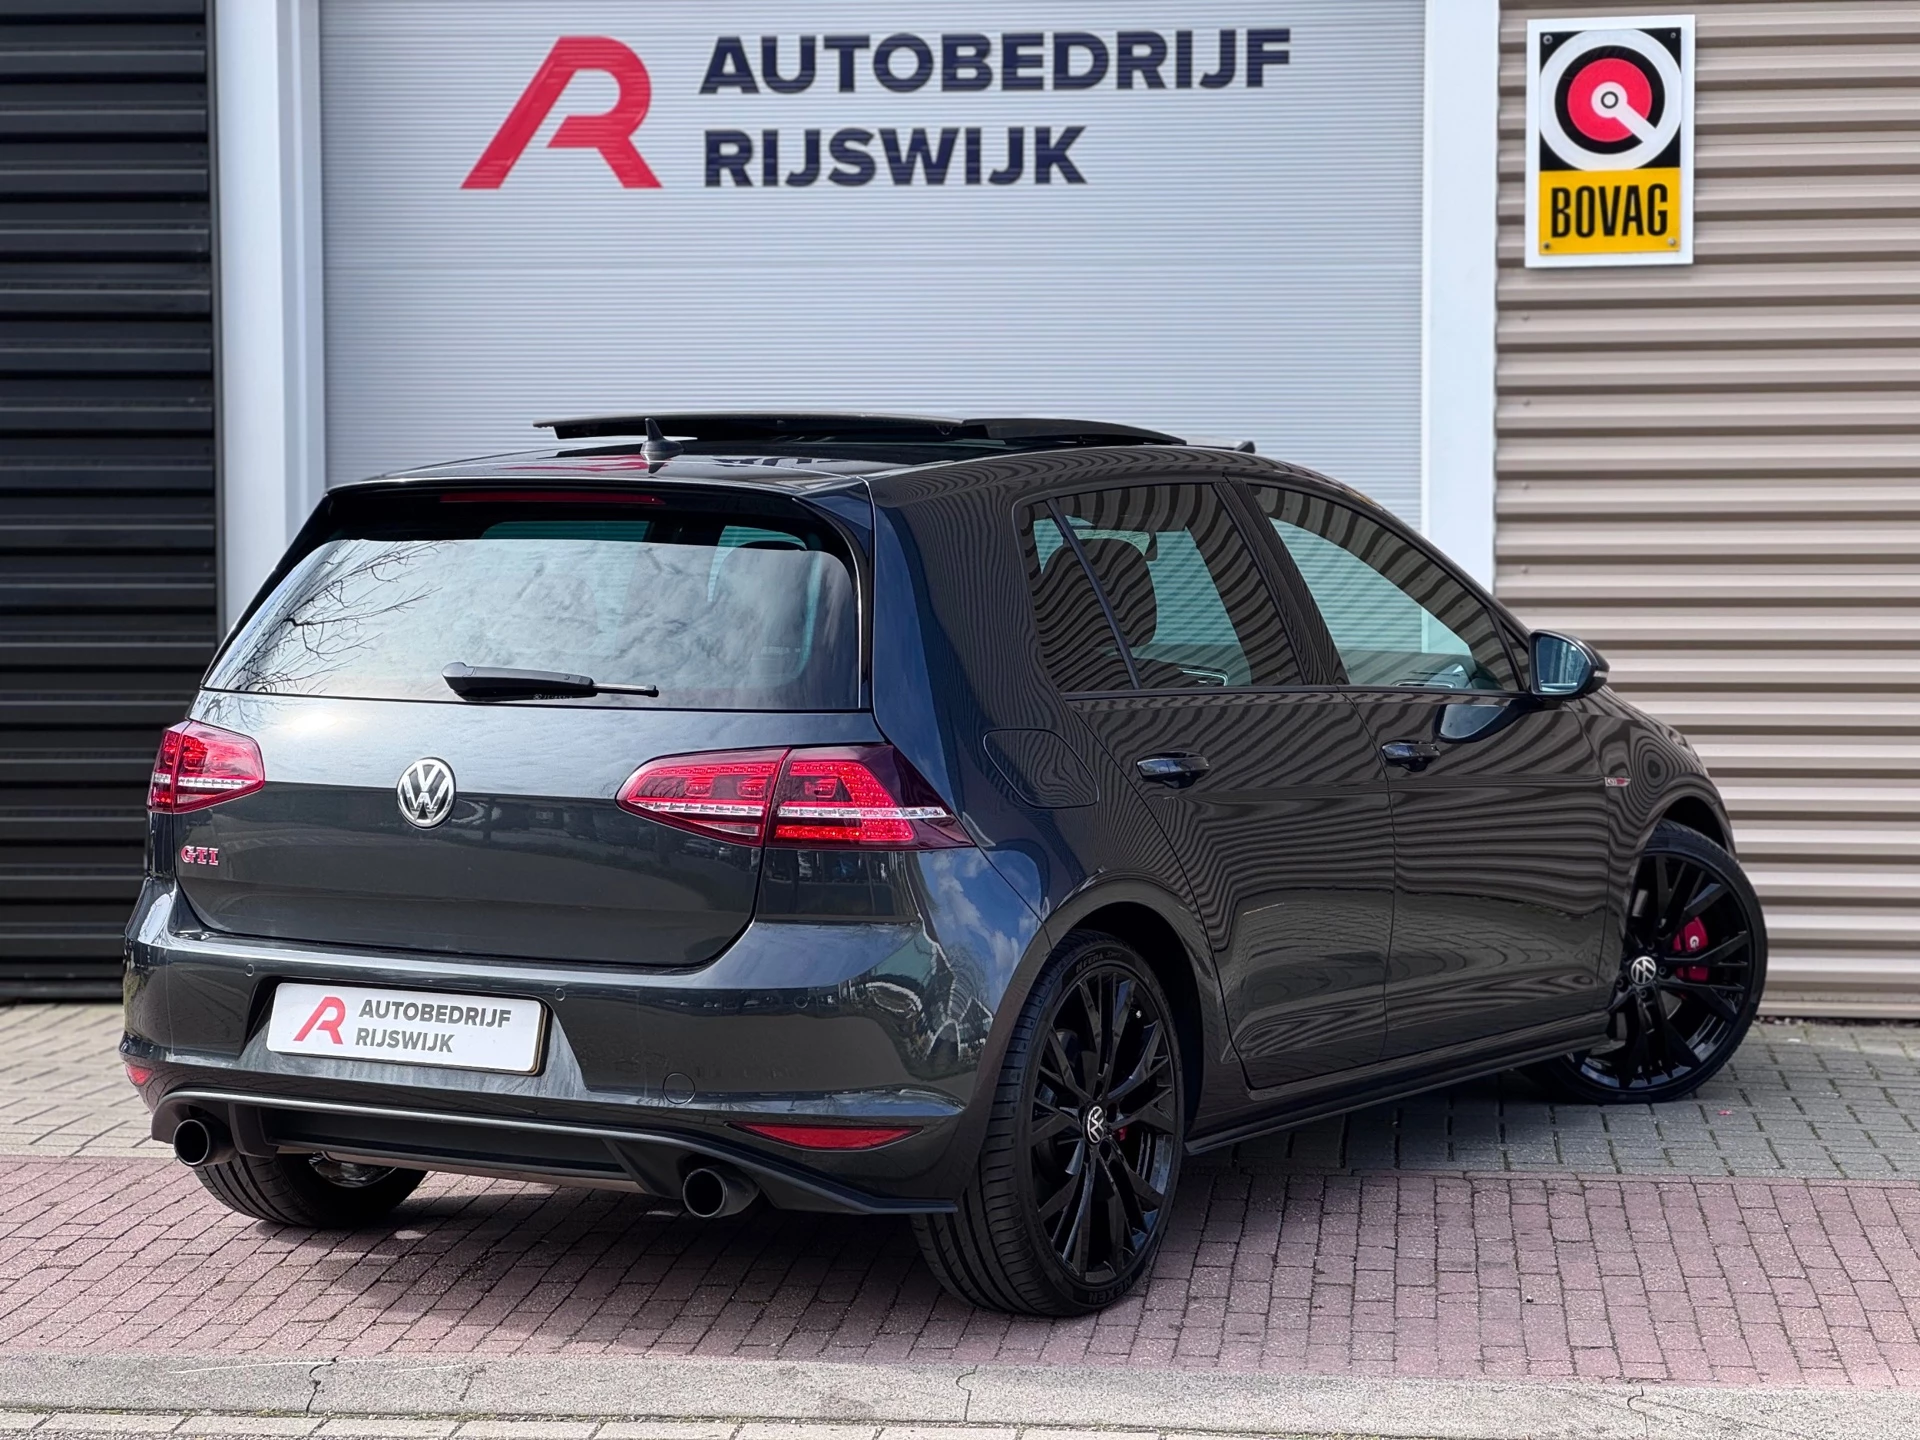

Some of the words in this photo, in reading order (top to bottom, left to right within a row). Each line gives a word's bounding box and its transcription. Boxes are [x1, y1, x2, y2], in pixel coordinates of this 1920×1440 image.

[699, 28, 1291, 94] AUTOBEDRIJF
[704, 126, 1087, 188] RIJSWIJK
[1551, 183, 1668, 238] BOVAG
[181, 845, 219, 866] GTI
[358, 999, 512, 1028] AUTOBEDRIJF
[355, 1027, 455, 1053] RIJSWIJK
